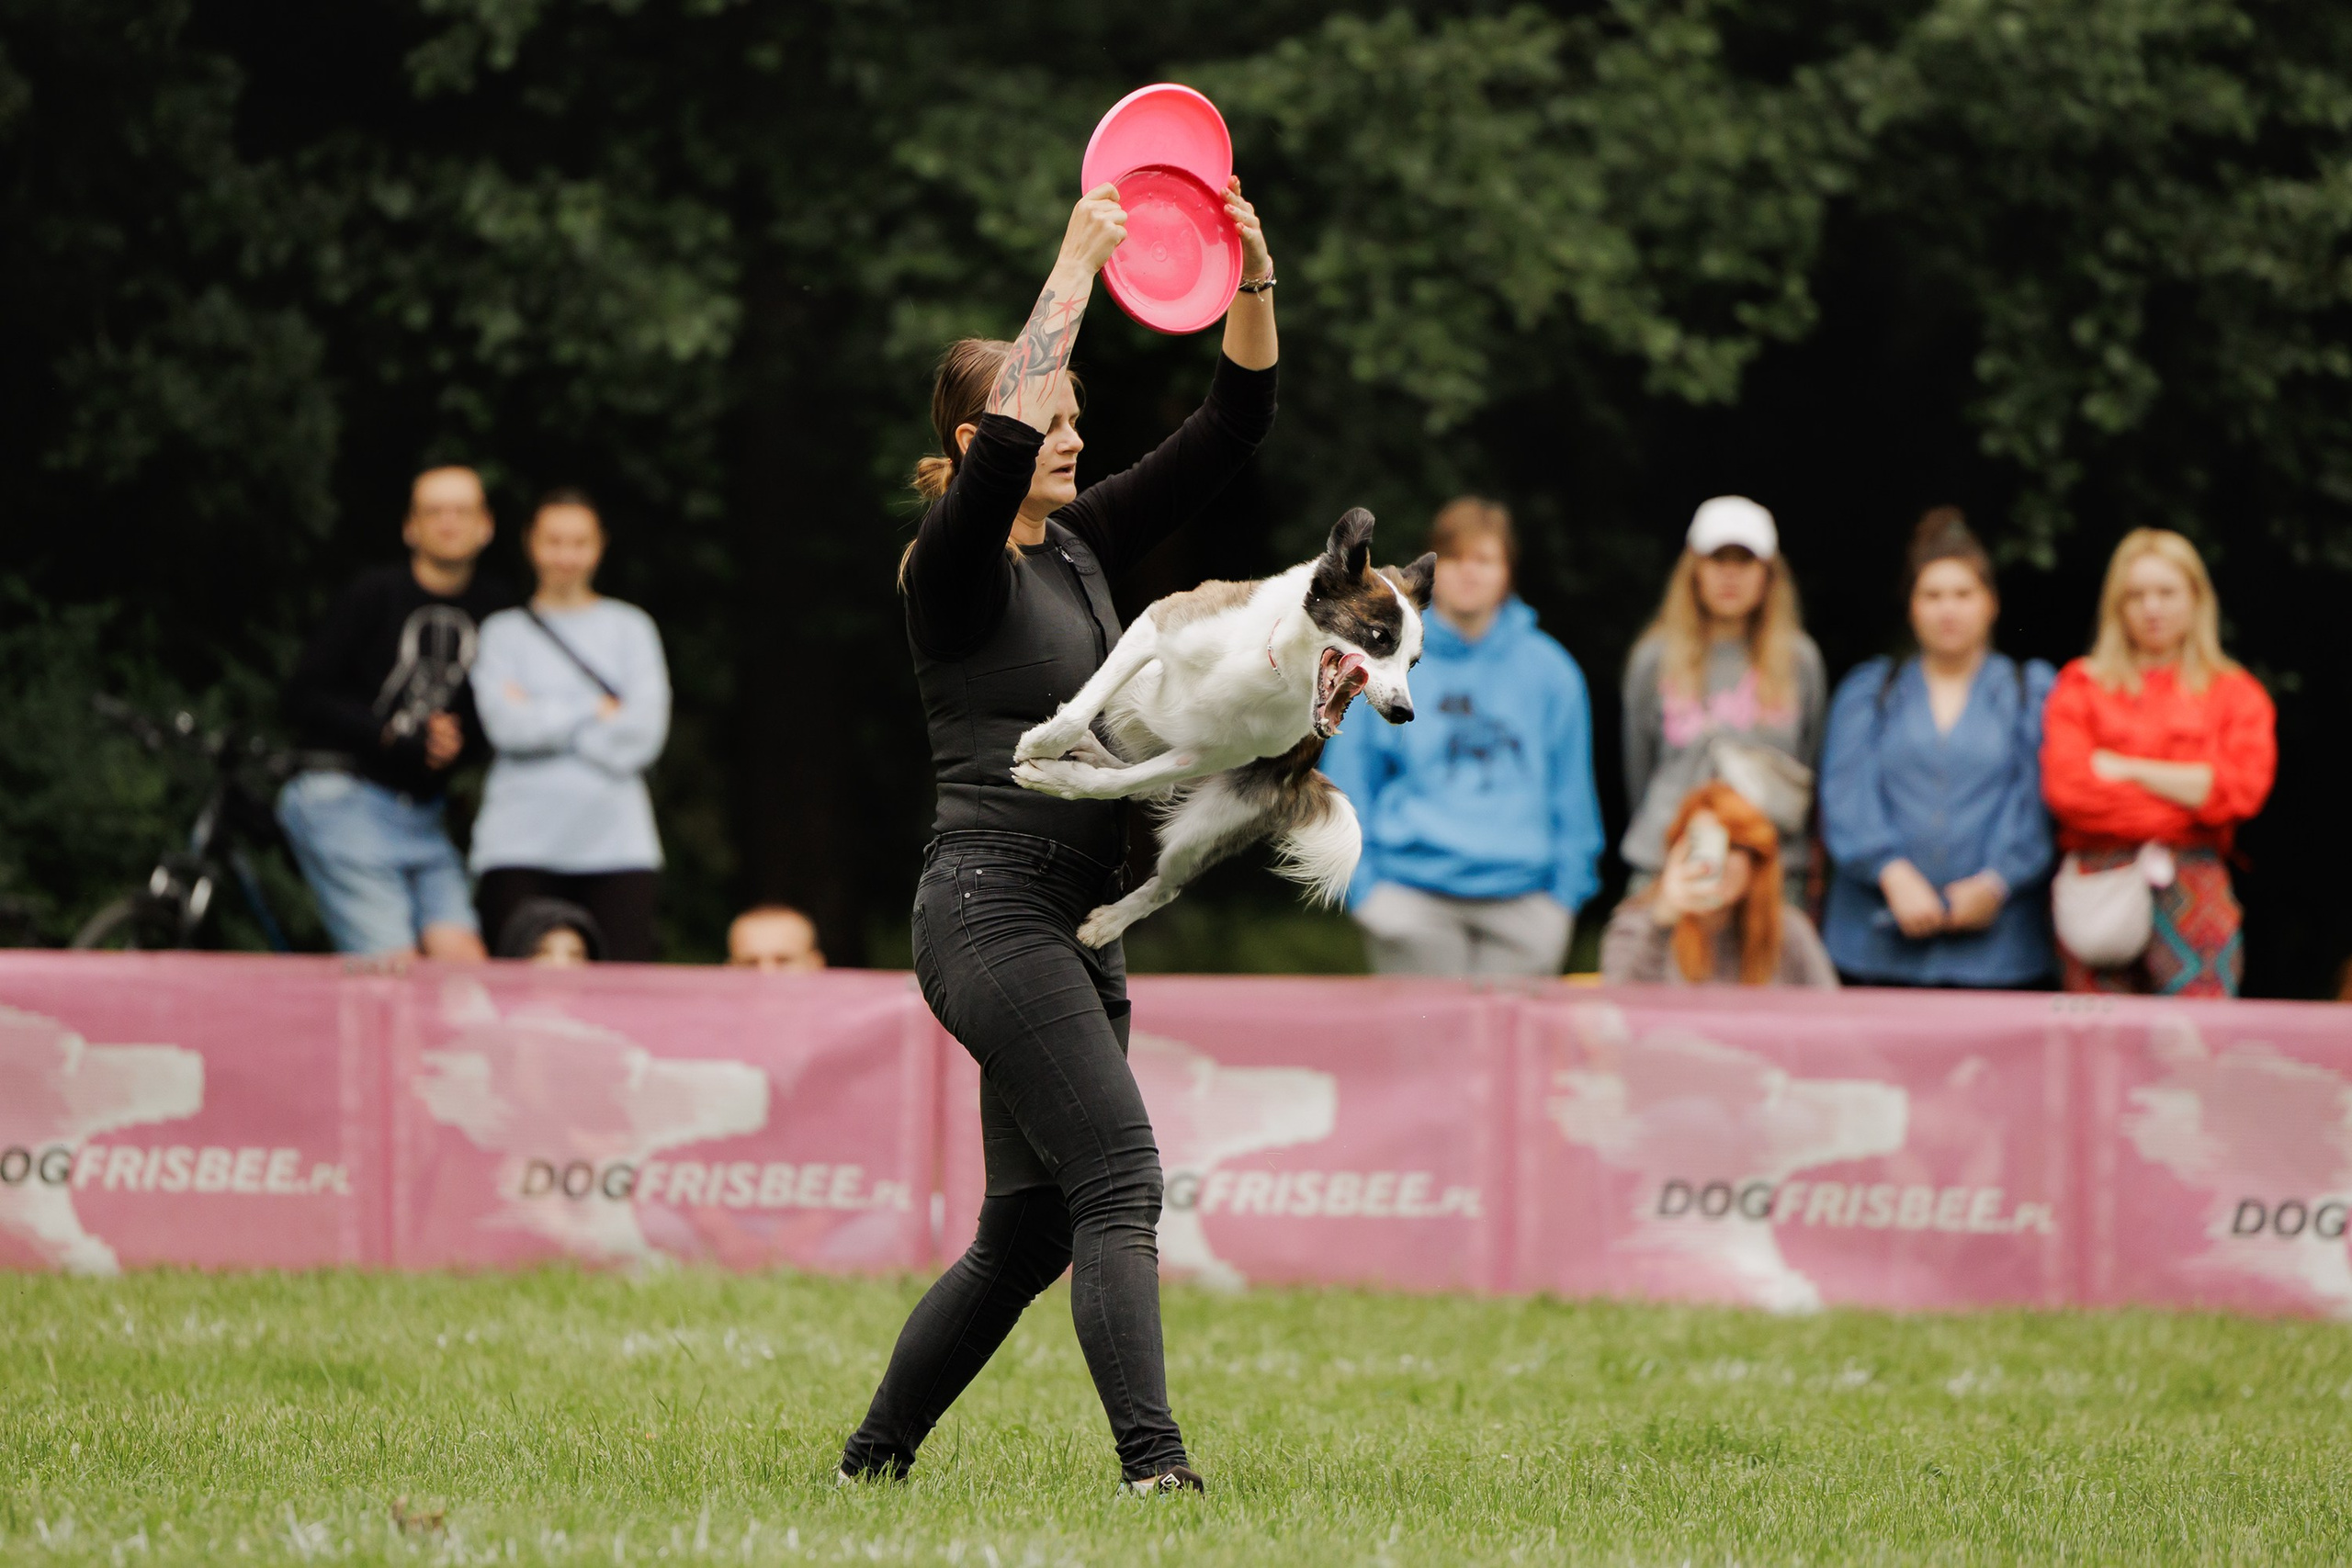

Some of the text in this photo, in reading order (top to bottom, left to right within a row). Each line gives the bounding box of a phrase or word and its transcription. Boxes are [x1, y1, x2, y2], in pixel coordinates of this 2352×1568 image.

[0, 1145, 352, 1194] OGFRISBEE.PL
[1164, 1169, 1482, 1218] GFRISBEE.PL
[1657, 1178, 2054, 1235] DOGFRISBEE.PL
[2233, 1198, 2346, 1239] DOG
